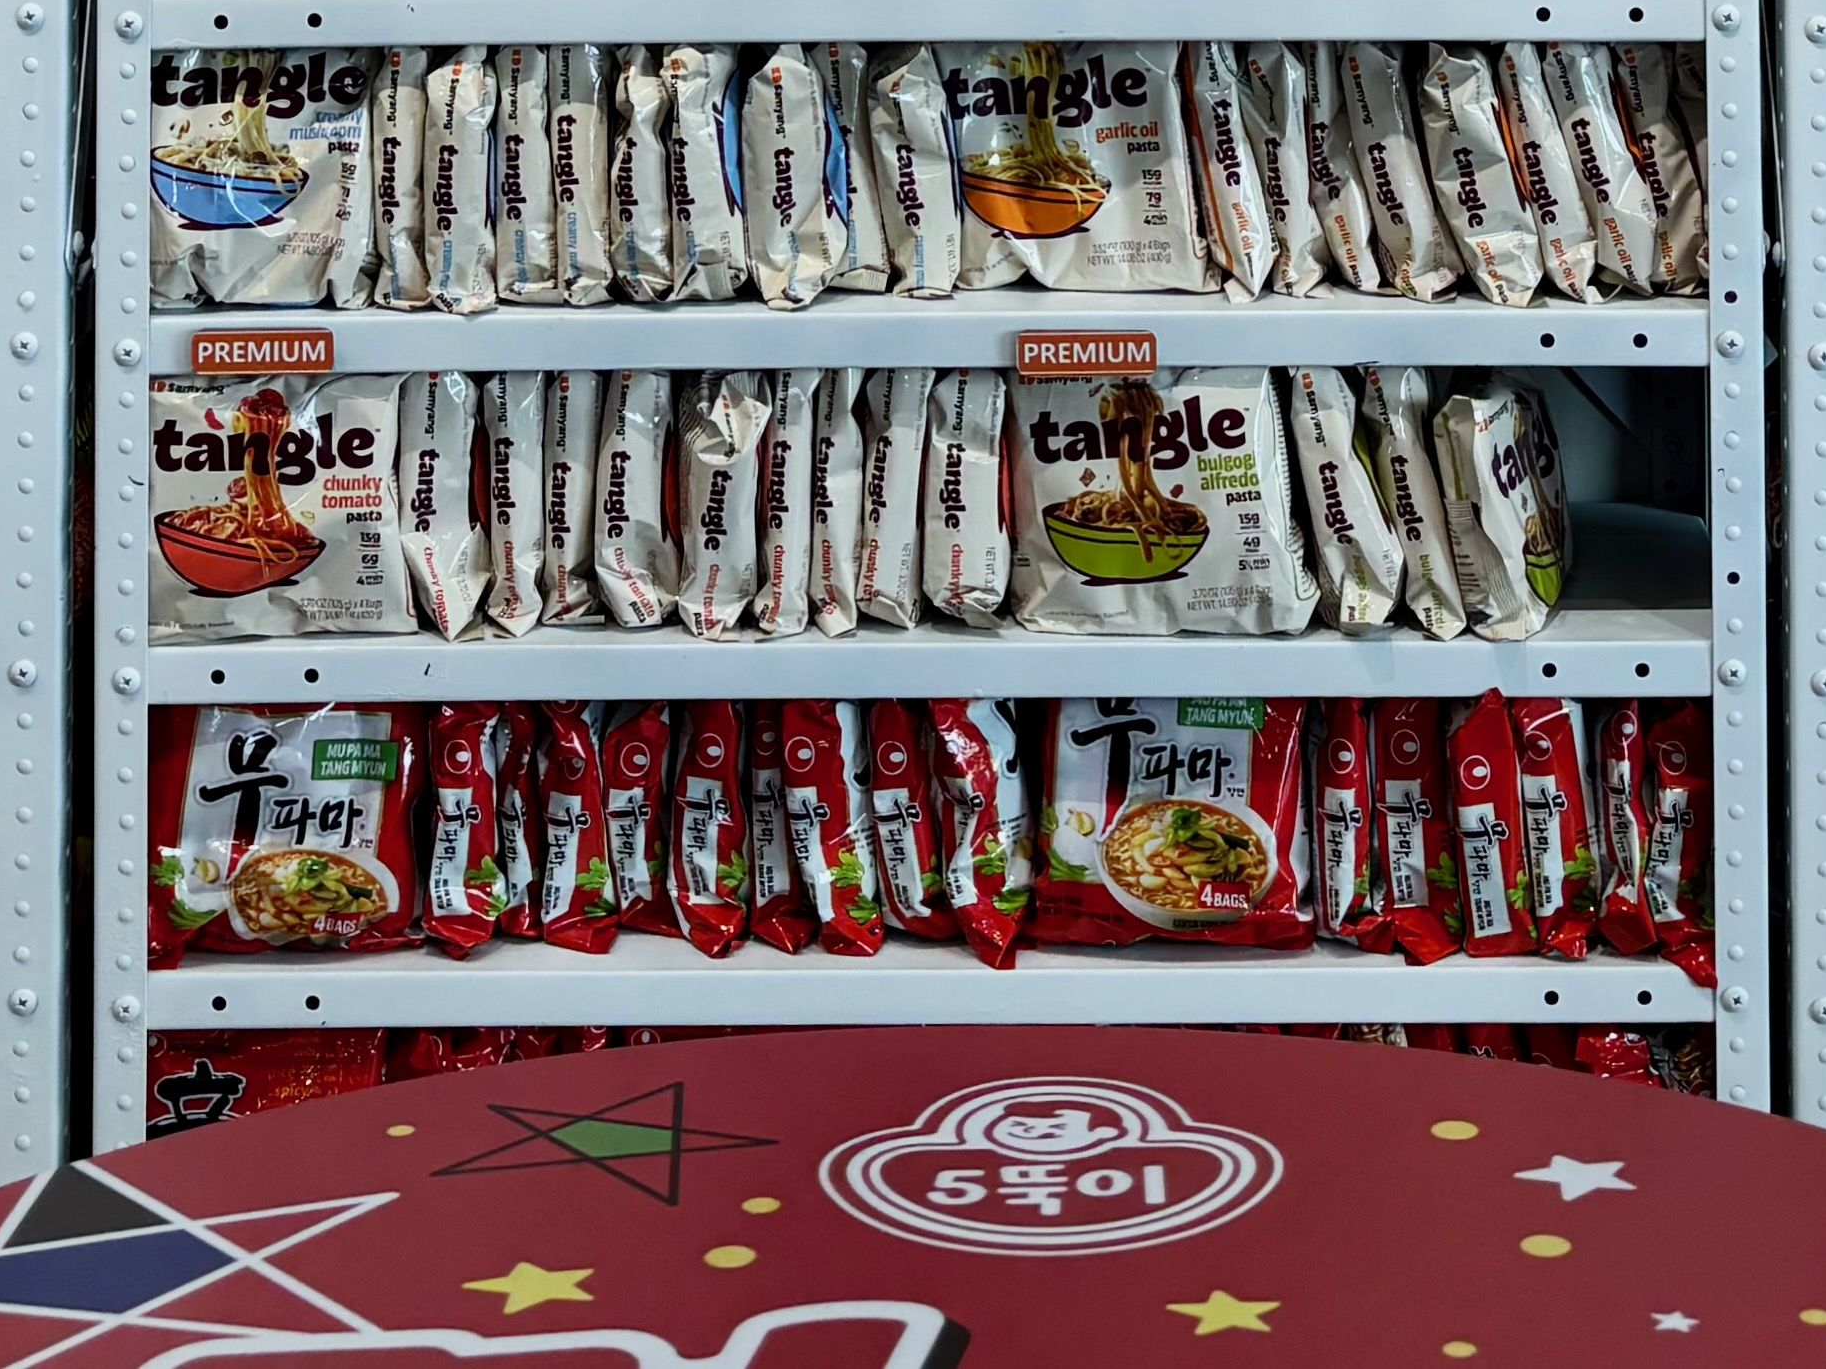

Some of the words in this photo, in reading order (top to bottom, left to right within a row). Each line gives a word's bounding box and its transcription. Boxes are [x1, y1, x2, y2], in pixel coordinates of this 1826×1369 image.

[943, 56, 1148, 129] tangle
[1095, 122, 1139, 145] garlic
[1140, 120, 1160, 139] oil
[1127, 137, 1161, 155] pasta
[197, 339, 328, 365] PREMIUM
[1022, 340, 1152, 366] PREMIUM
[152, 414, 375, 486] tangle
[1029, 403, 1246, 470] tangle
[925, 1163, 1168, 1218] 5뚝이
